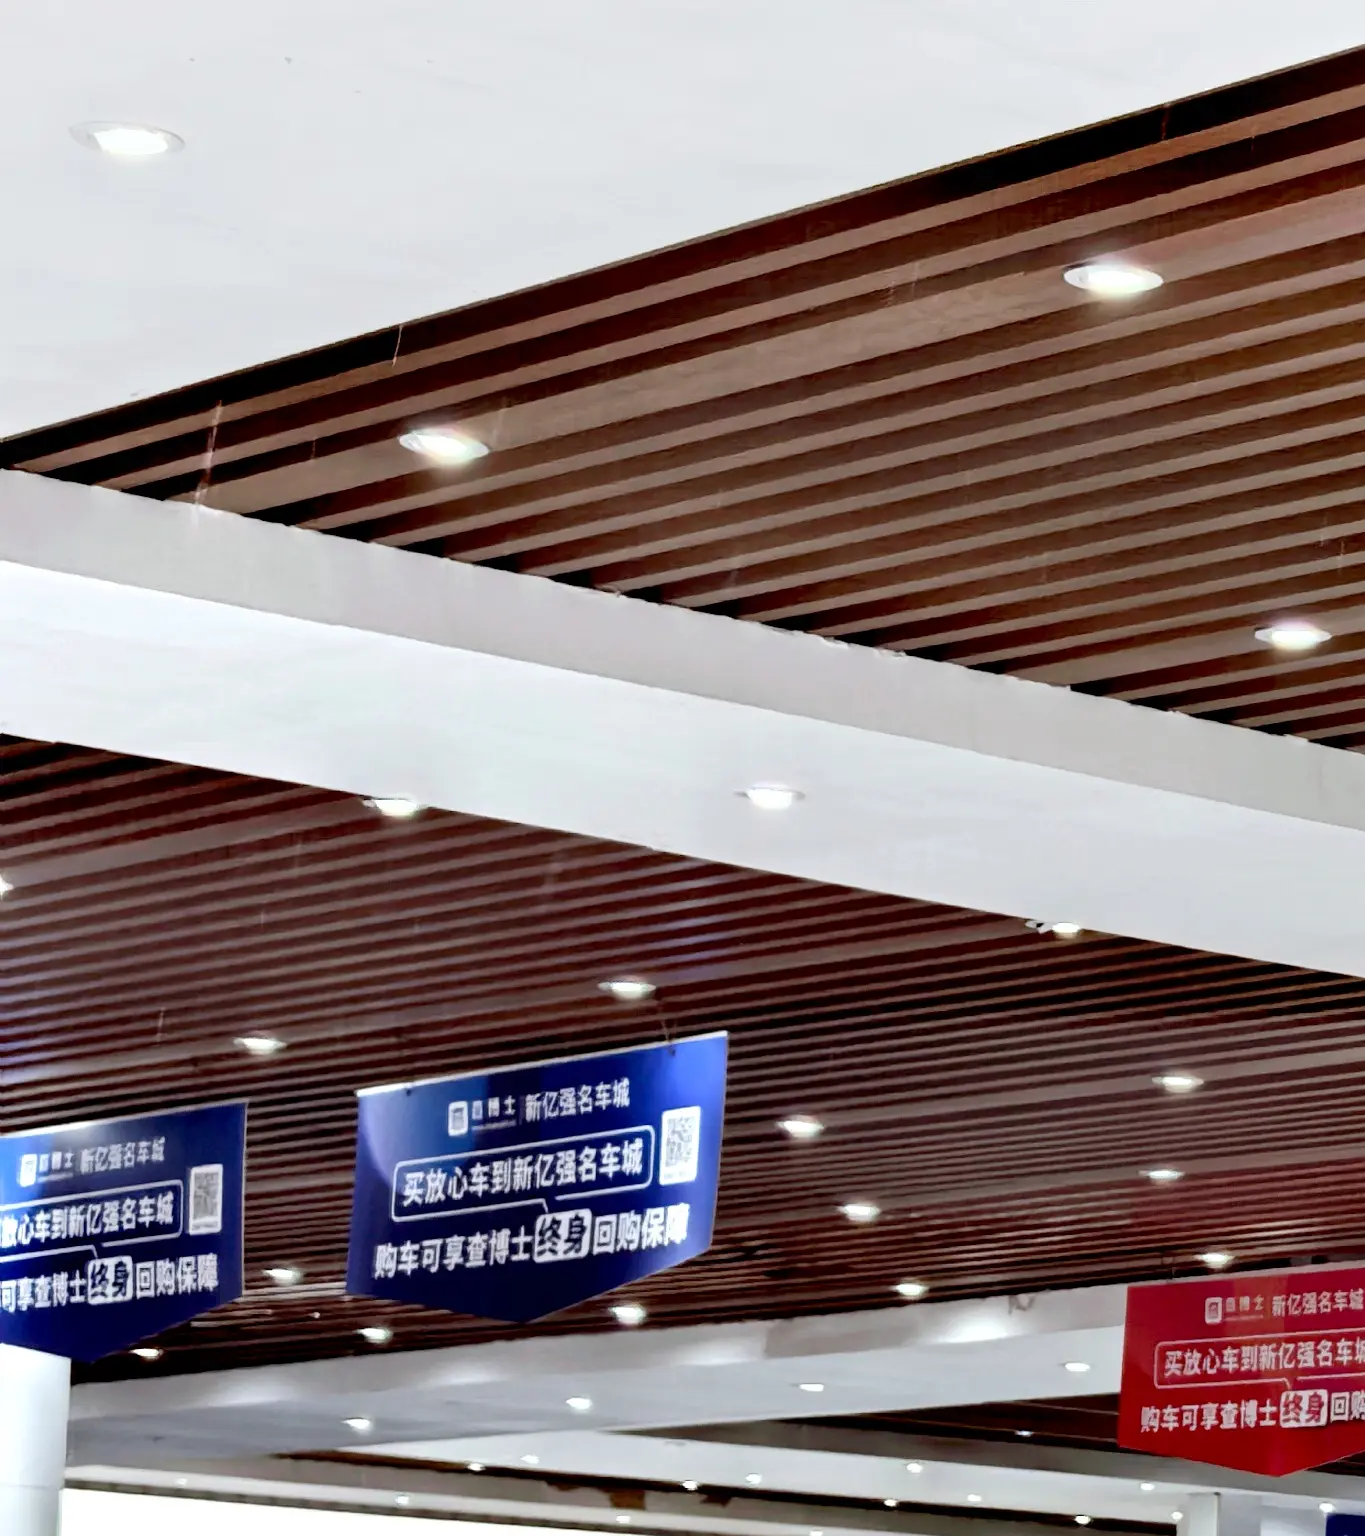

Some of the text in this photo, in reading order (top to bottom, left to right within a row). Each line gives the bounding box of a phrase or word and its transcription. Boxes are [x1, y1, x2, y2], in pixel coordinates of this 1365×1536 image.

[525, 1077, 631, 1123] 新亿强名车城
[80, 1136, 166, 1175] 新亿强名车城
[402, 1138, 644, 1206] 买放心车到新亿强名车城
[373, 1203, 691, 1280] 购车可享查博士终身回购保障
[1271, 1288, 1365, 1317] 新亿强名车城
